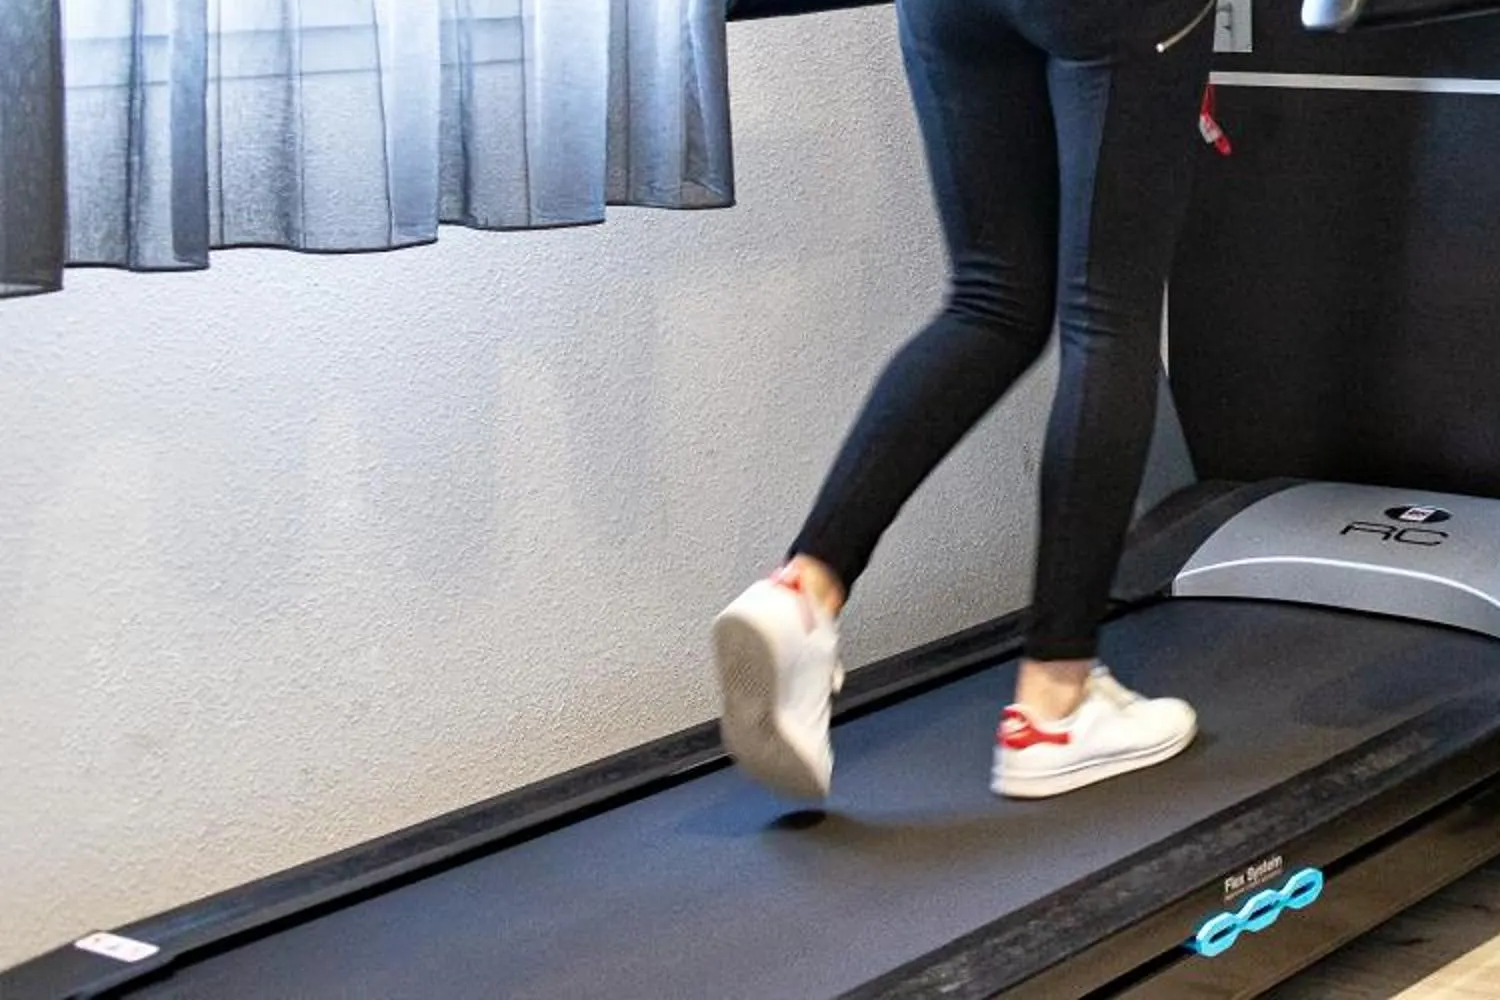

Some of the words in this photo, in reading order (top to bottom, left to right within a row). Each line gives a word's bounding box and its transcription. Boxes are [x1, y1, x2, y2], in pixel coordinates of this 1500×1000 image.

[1340, 521, 1450, 546] RC
[1223, 874, 1245, 893] Flex
[1246, 855, 1283, 885] System
